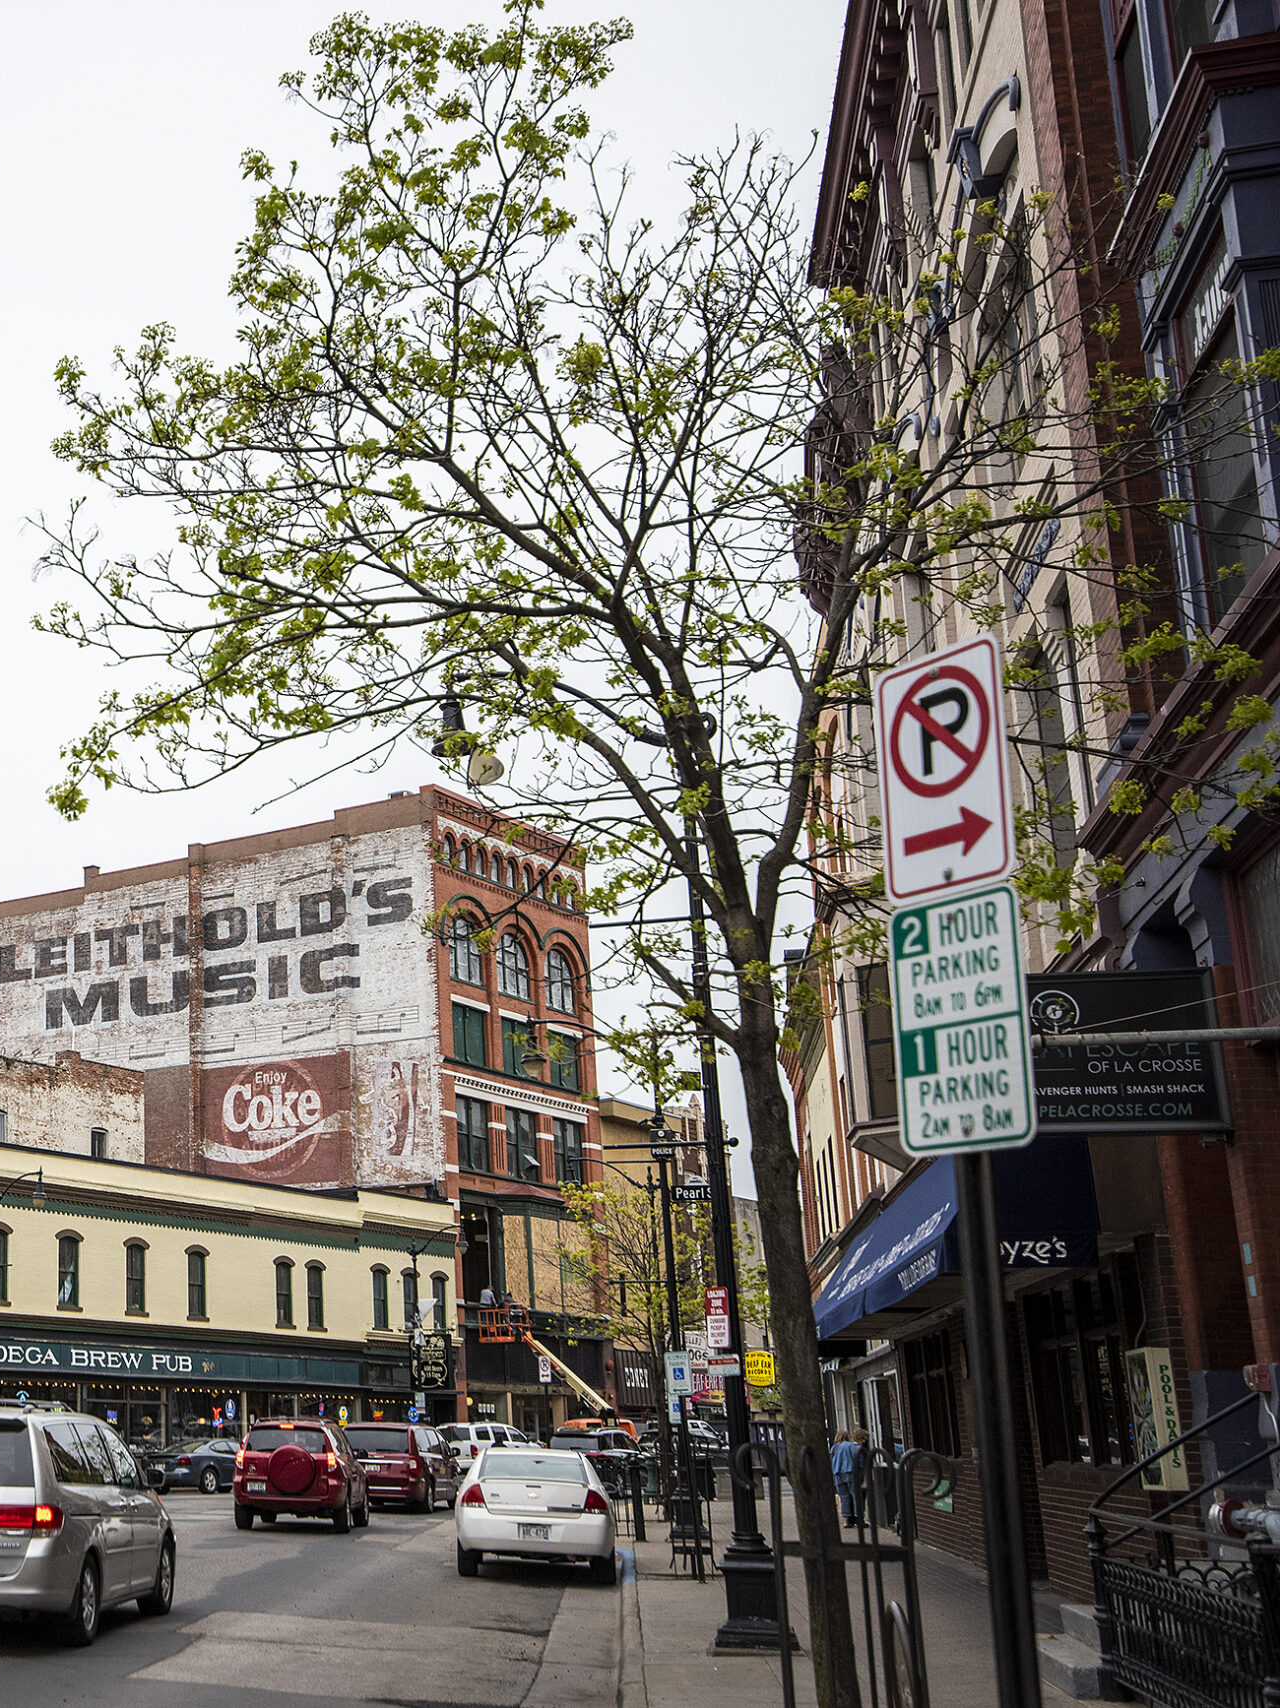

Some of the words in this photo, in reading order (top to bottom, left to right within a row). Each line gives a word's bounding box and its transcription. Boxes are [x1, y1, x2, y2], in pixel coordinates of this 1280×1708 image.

[0, 877, 414, 985] LEITHOLD'S
[900, 916, 923, 954] 2
[939, 901, 999, 947] HOUR
[911, 945, 1000, 988] PARKING
[45, 943, 361, 1031] MUSIC
[914, 993, 943, 1019] 8AM
[951, 991, 967, 1011] TO
[974, 981, 1002, 1008] 6PM
[914, 1031, 926, 1073] 1
[947, 1023, 1008, 1068] HOUR
[1088, 1061, 1109, 1074] OF
[1114, 1060, 1134, 1073] LA
[1138, 1058, 1203, 1072] CROSSE
[255, 1071, 287, 1085] Enjoy
[919, 1069, 1011, 1107] PARKING
[1085, 1085, 1118, 1095] HUNTS
[1126, 1084, 1164, 1094] SMASH
[1167, 1083, 1205, 1094] SHACK
[222, 1084, 321, 1132] Coke
[921, 1112, 951, 1139] 2AM
[982, 1104, 1013, 1132] 8AM
[652, 1147, 673, 1155] POLICE
[675, 1187, 705, 1199] Pearl
[70, 1348, 143, 1370] BREW
[151, 1353, 193, 1372] PUB
[746, 1360, 759, 1369] DEAF
[761, 1360, 772, 1370] EAR
[1159, 1364, 1173, 1404] POOL
[1164, 1406, 1175, 1417] &
[1166, 1418, 1182, 1469] DATS
